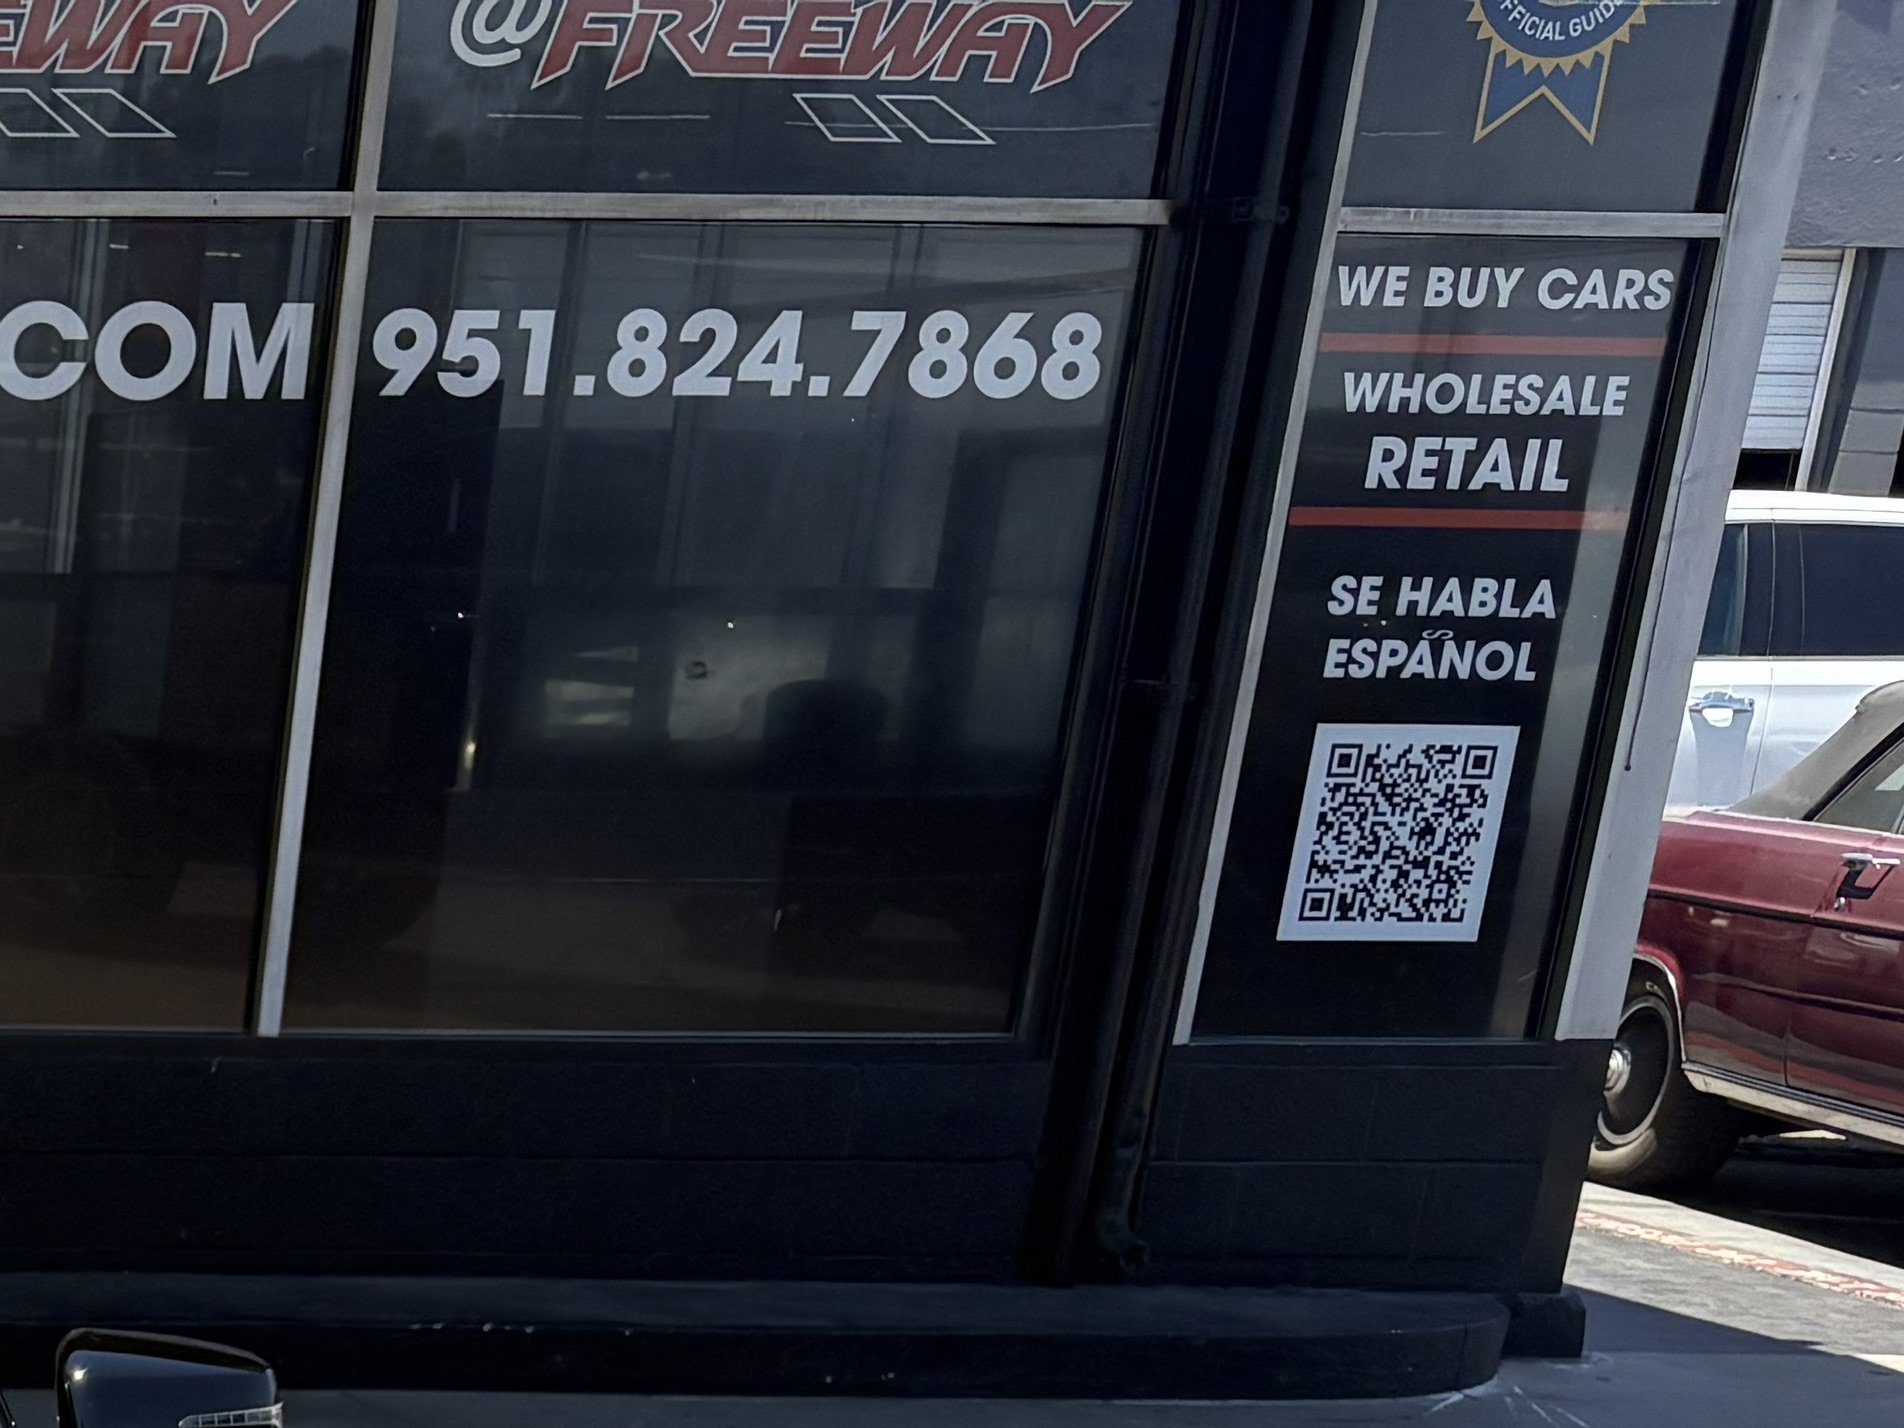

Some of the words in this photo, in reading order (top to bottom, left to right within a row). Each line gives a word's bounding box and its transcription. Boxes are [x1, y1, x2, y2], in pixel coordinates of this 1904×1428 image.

[1338, 265, 1410, 306] WE
[1424, 266, 1525, 308] BUY
[1538, 268, 1674, 310] CARS
[372, 308, 1103, 400] 951.824.7868
[1343, 371, 1631, 416] WHOLESALE
[1365, 436, 1569, 492] RETAIL
[1327, 575, 1384, 615] SE
[1396, 576, 1556, 619] HABLA
[1323, 629, 1536, 681] ESPAÑOL
